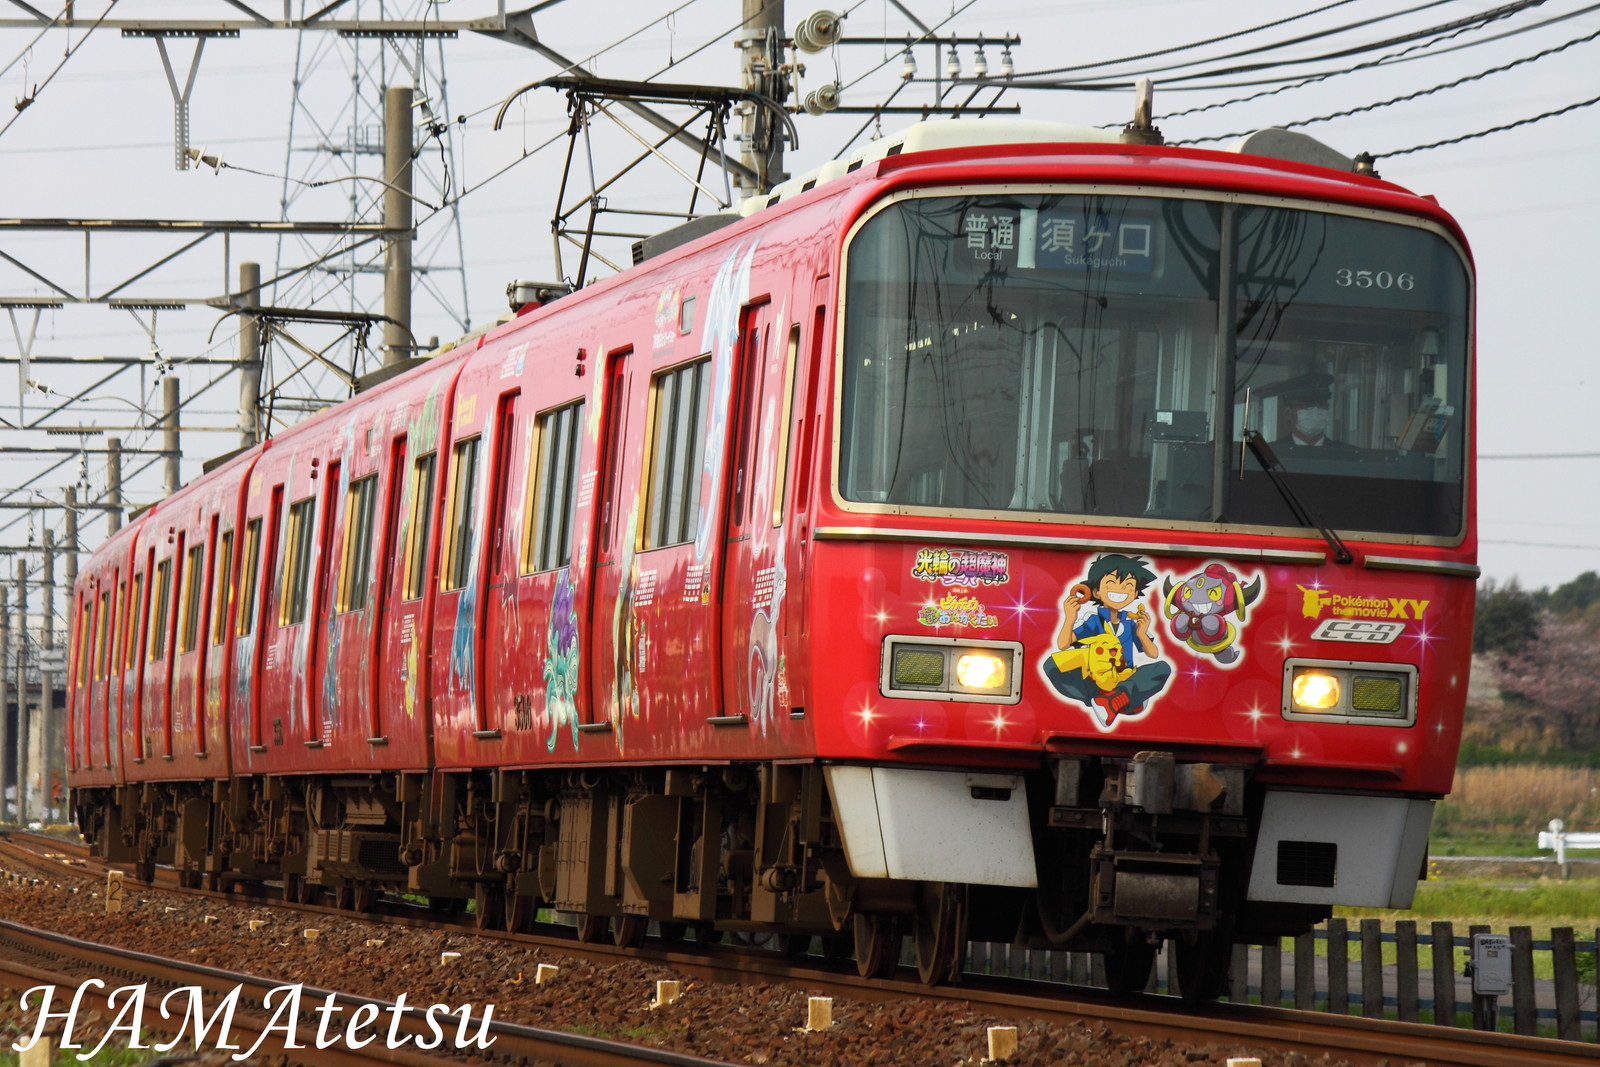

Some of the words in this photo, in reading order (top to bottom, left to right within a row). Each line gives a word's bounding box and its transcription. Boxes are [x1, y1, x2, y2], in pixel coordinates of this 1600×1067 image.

[965, 213, 1014, 250] 普通
[975, 250, 1002, 261] Local
[1065, 255, 1126, 268] Sukaguchi
[1335, 268, 1415, 291] 3506
[915, 549, 1008, 576] 光輪の超魔神
[1332, 595, 1388, 608] Pokémon
[1388, 598, 1431, 620] XY
[939, 611, 998, 627] おんがくたい
[1351, 608, 1388, 618] movie
[109, 879, 122, 902] 2
